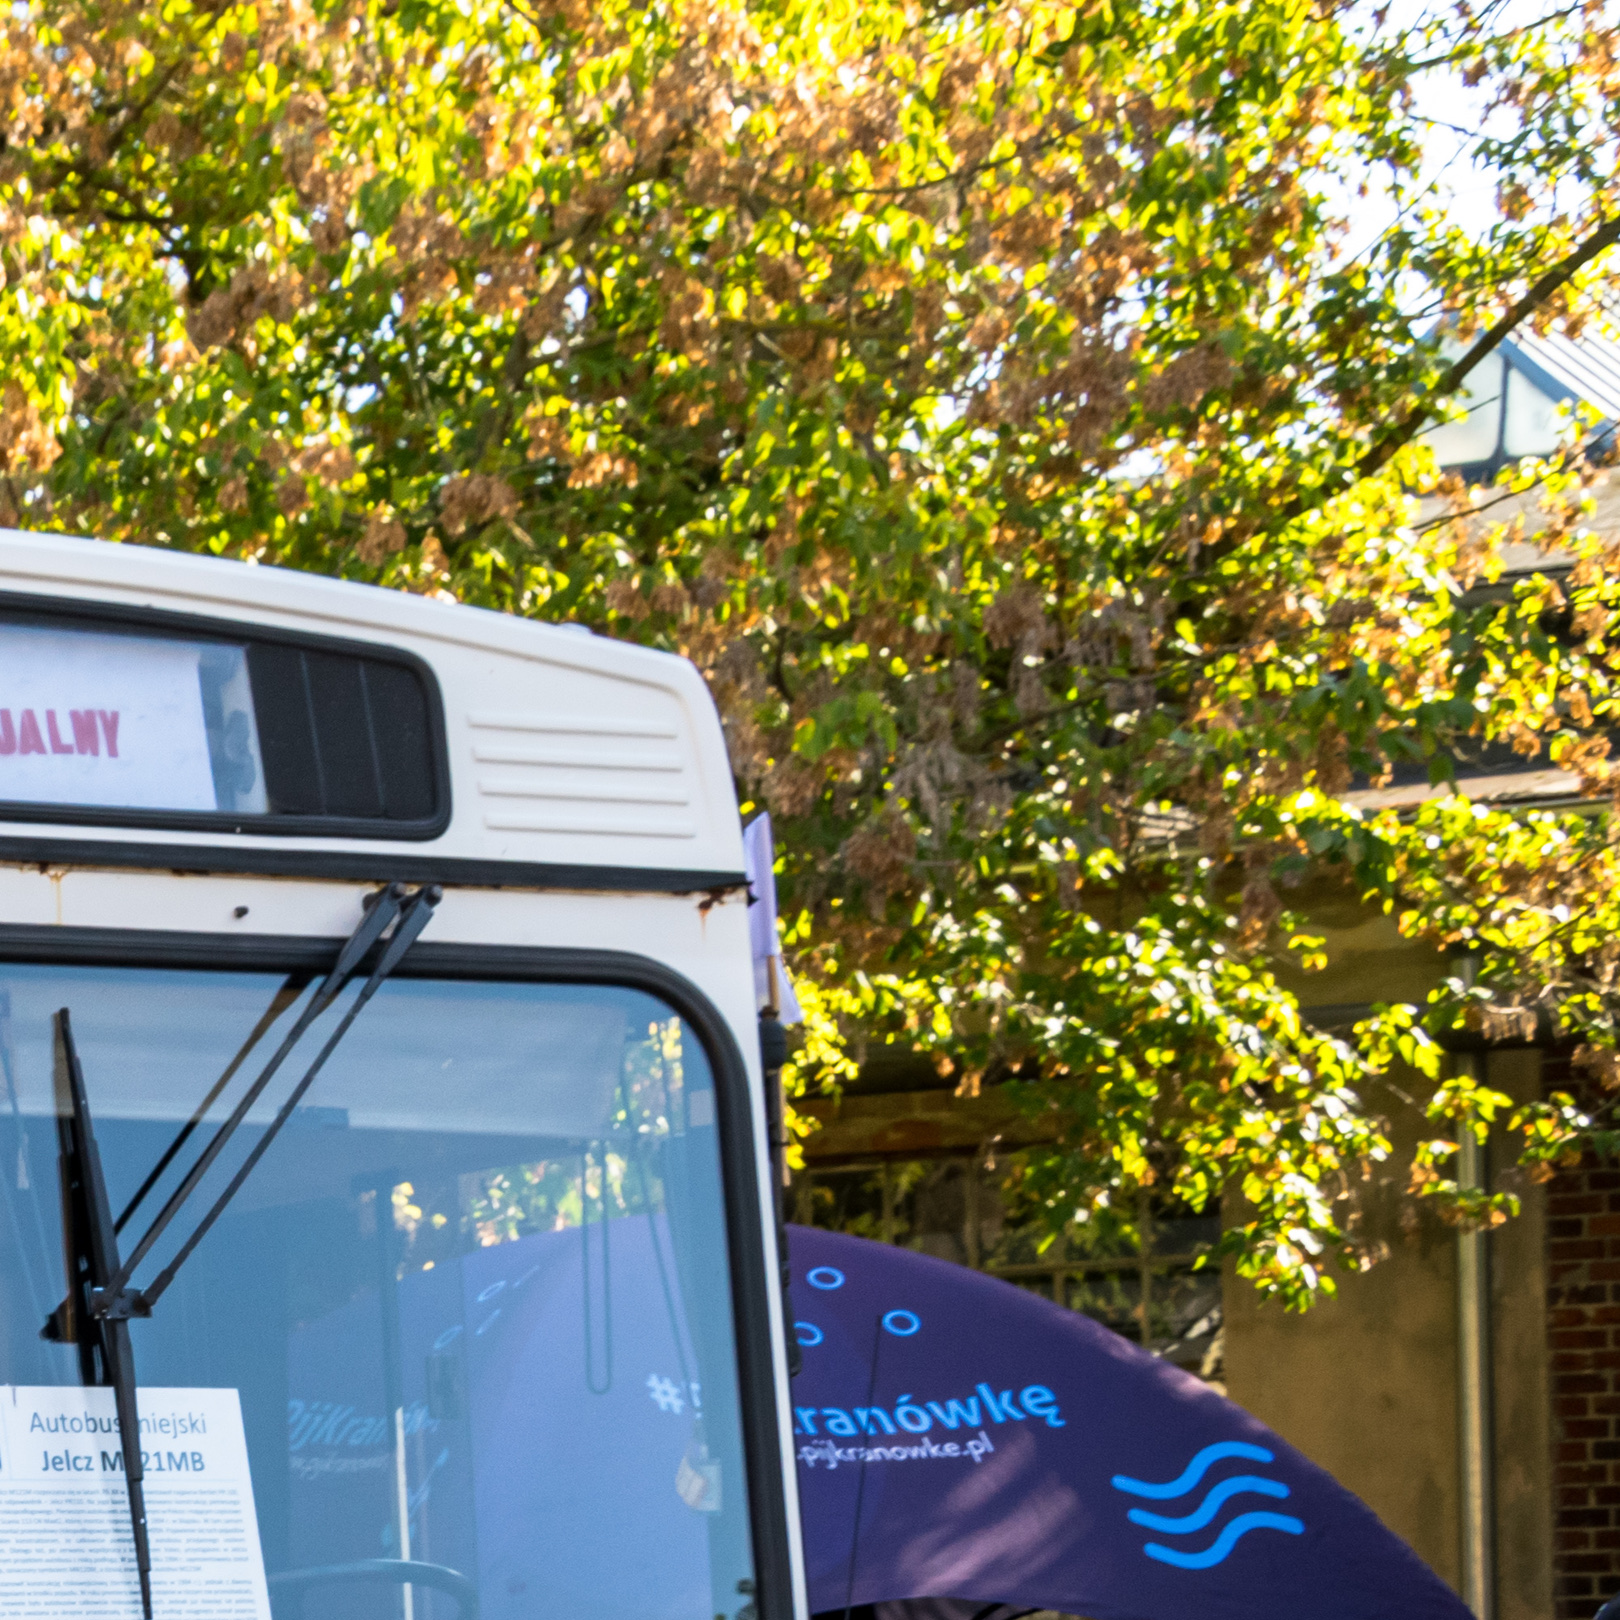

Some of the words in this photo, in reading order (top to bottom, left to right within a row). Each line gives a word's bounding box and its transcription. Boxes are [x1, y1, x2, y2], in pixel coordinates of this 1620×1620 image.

[794, 1382, 1066, 1436] ranówkę
[30, 1411, 122, 1433] Autobus
[42, 1450, 94, 1472] Jelcz
[101, 1450, 205, 1472] M21MB
